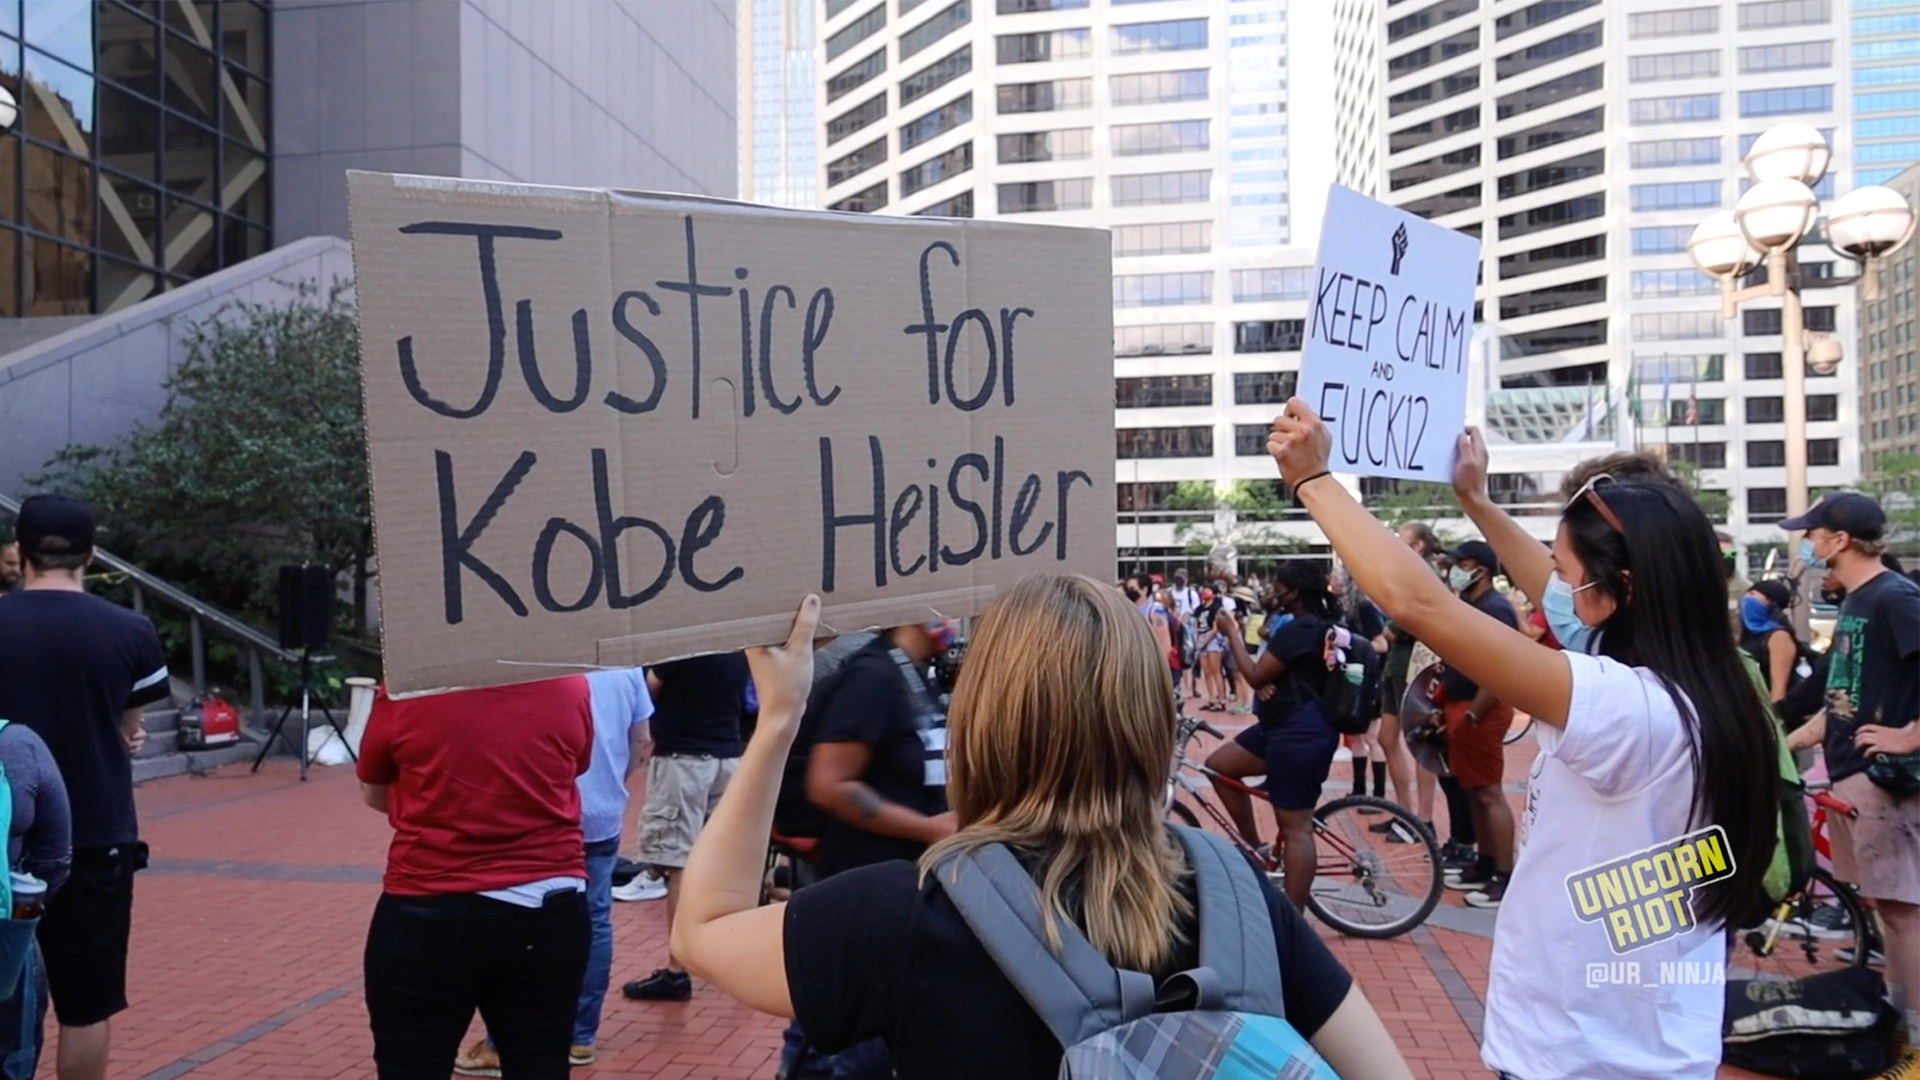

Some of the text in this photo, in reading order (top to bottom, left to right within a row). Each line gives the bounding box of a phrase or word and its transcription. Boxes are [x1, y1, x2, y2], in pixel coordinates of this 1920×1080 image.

[396, 214, 1035, 419] Justice for
[1311, 267, 1466, 374] KEEP CALM
[1370, 361, 1395, 382] AND
[434, 434, 1093, 625] Kobe Heisler
